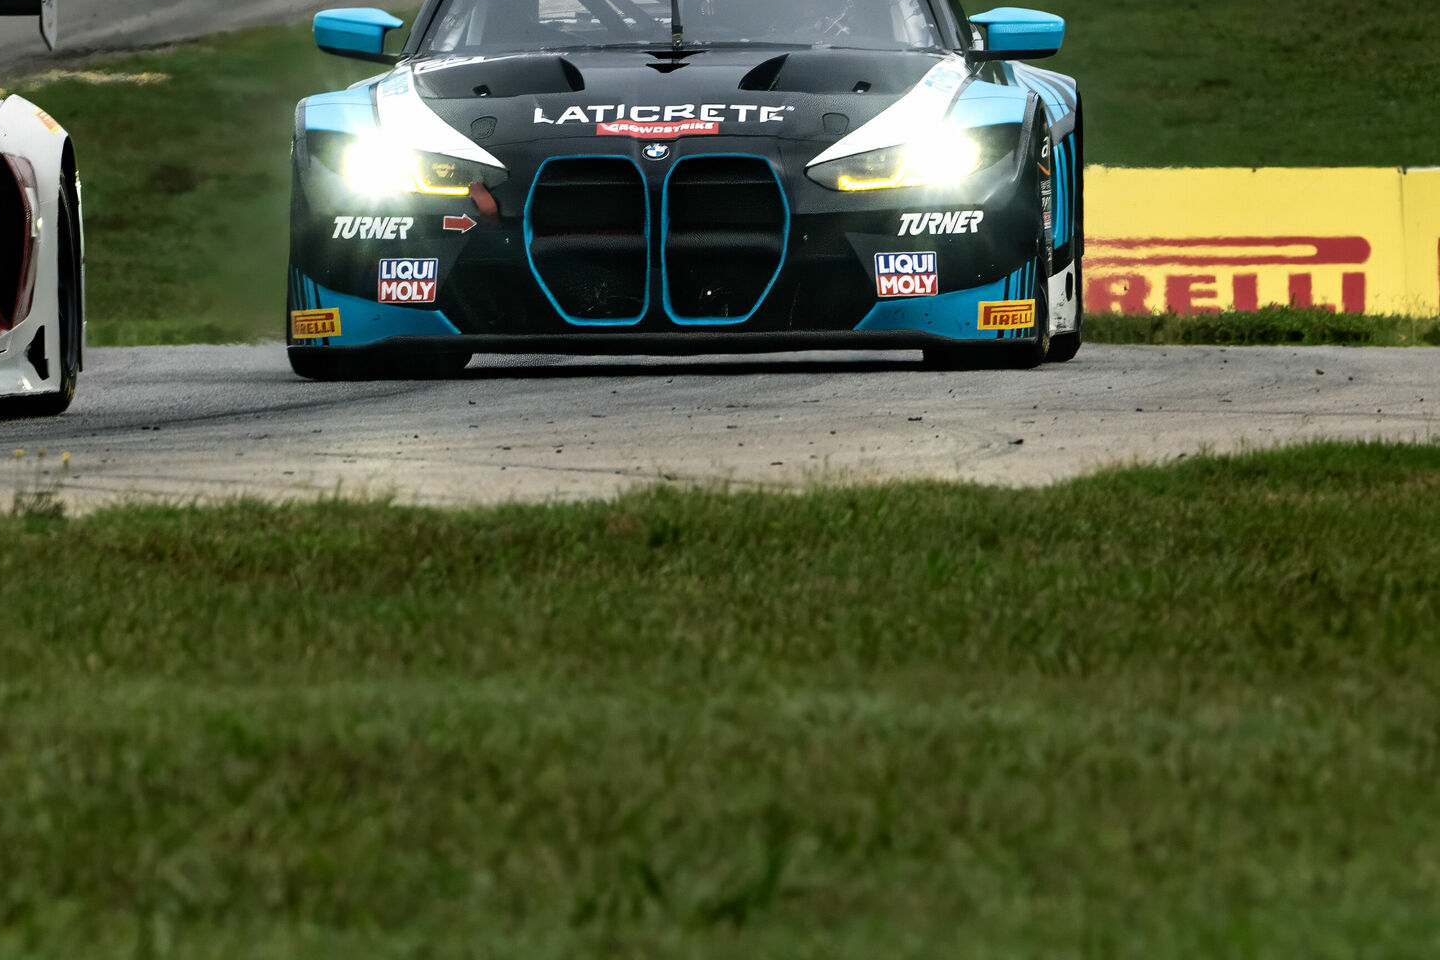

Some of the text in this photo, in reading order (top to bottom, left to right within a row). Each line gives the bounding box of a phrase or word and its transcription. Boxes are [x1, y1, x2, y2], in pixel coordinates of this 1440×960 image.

[534, 104, 785, 125] LATICRETE
[607, 122, 715, 133] CROWDSTRIKE
[332, 216, 414, 239] TURNER
[897, 210, 984, 236] TURNER
[381, 261, 434, 280] LIQUI
[878, 254, 934, 274] LIQUI
[380, 281, 435, 301] MOLY
[880, 274, 937, 295] MOLY
[983, 304, 1032, 325] PIRELLI
